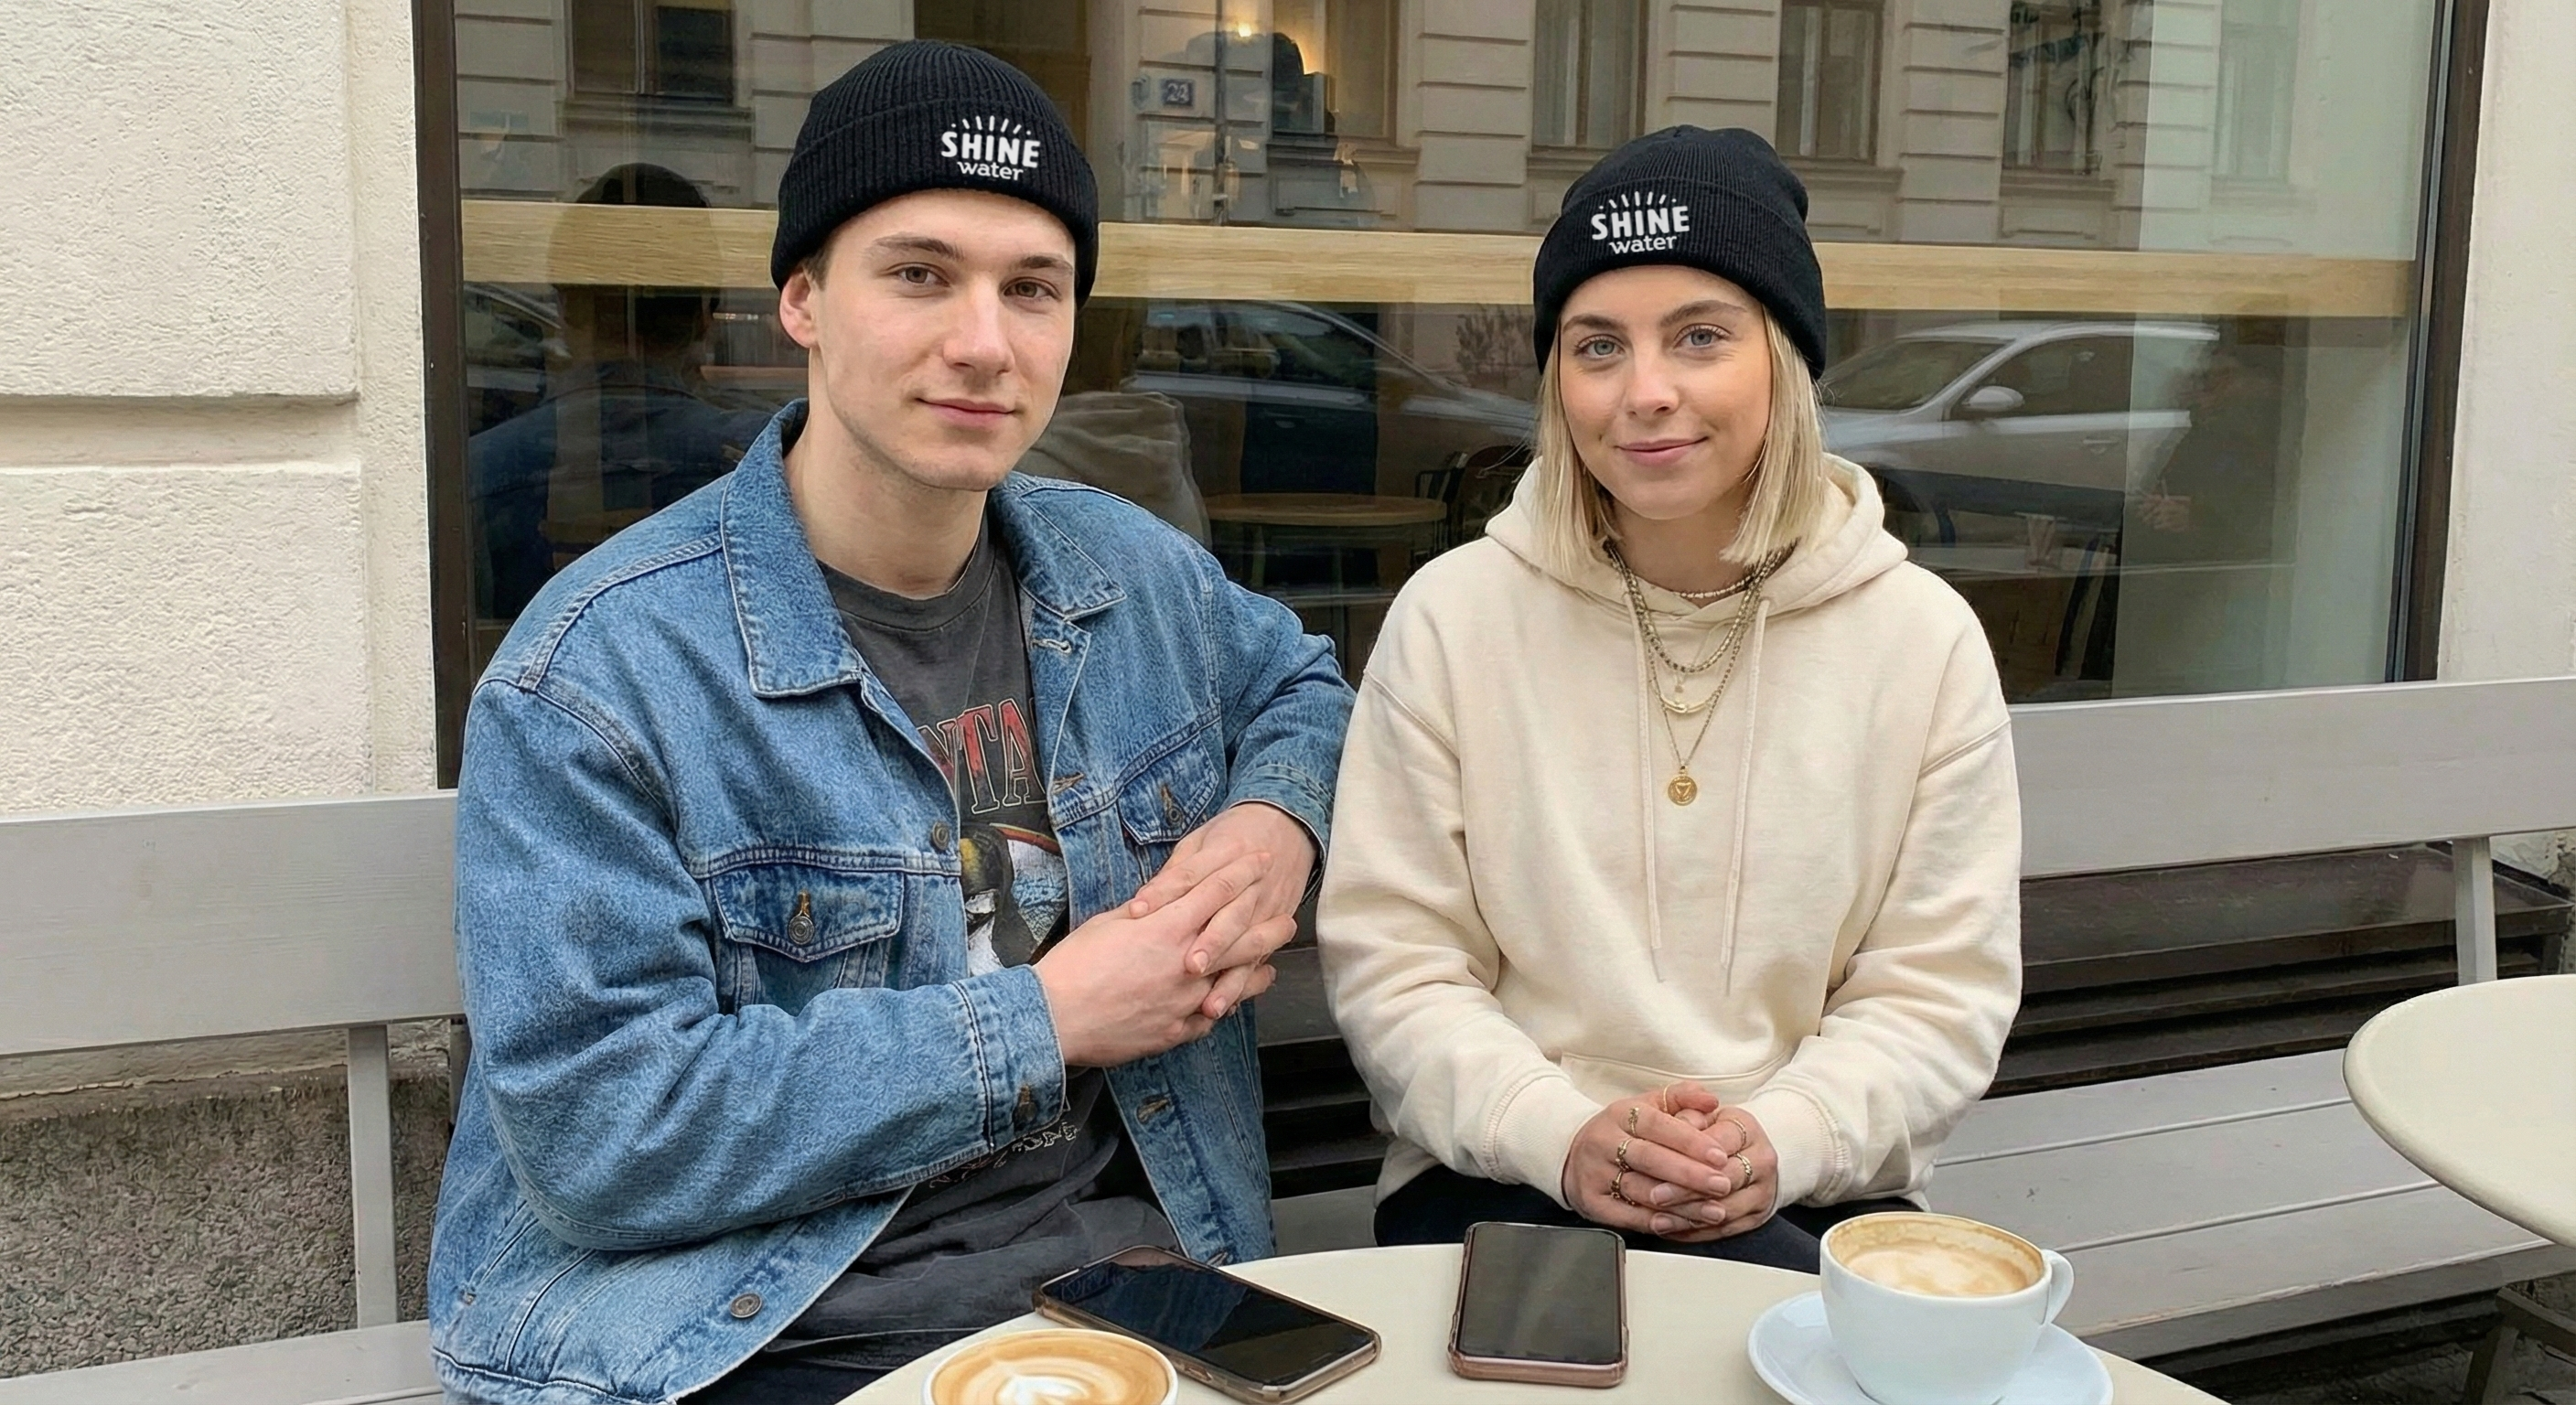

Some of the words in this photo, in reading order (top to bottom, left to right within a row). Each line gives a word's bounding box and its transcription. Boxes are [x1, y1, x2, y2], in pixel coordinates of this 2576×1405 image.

[940, 131, 1041, 168] SHINE
[957, 161, 1024, 181] water
[1591, 206, 1690, 241] SHINE
[1608, 235, 1678, 254] water
[917, 697, 1048, 815] NTA
